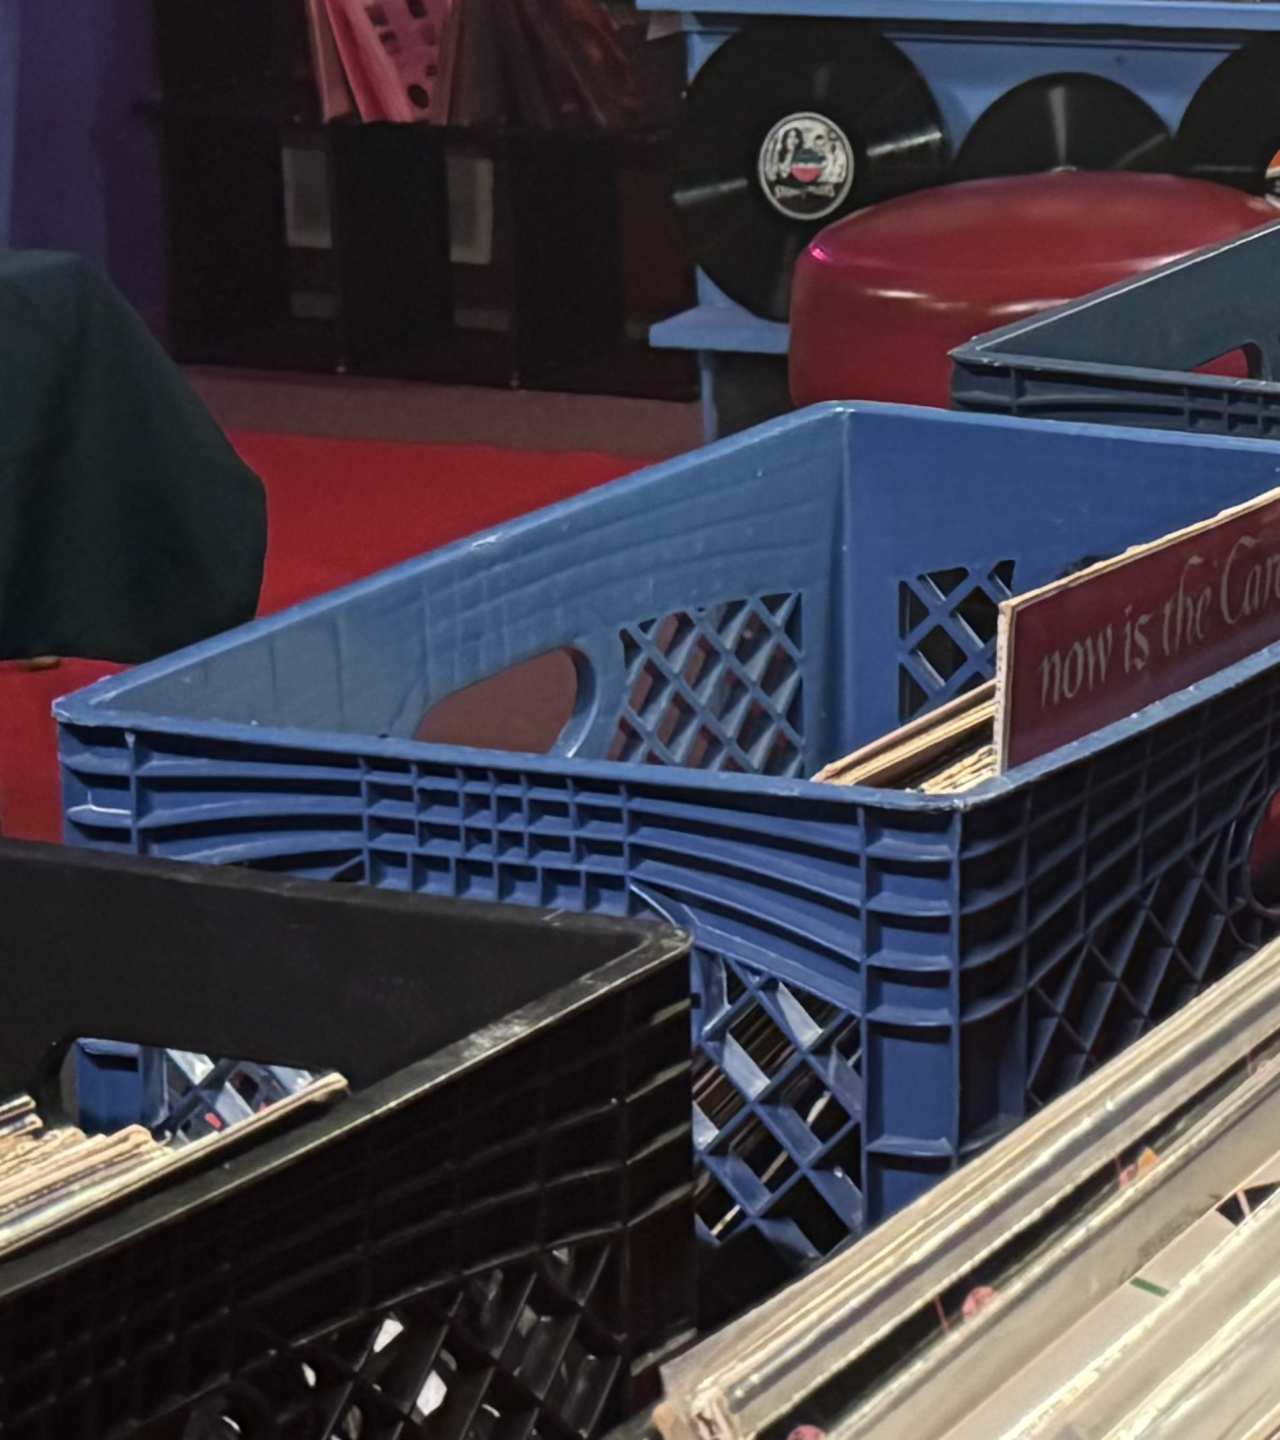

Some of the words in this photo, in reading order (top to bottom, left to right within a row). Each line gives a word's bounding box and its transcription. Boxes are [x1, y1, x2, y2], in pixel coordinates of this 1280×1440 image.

[1040, 635, 1112, 708] now
[1124, 606, 1150, 672] is
[1162, 556, 1213, 649] the
